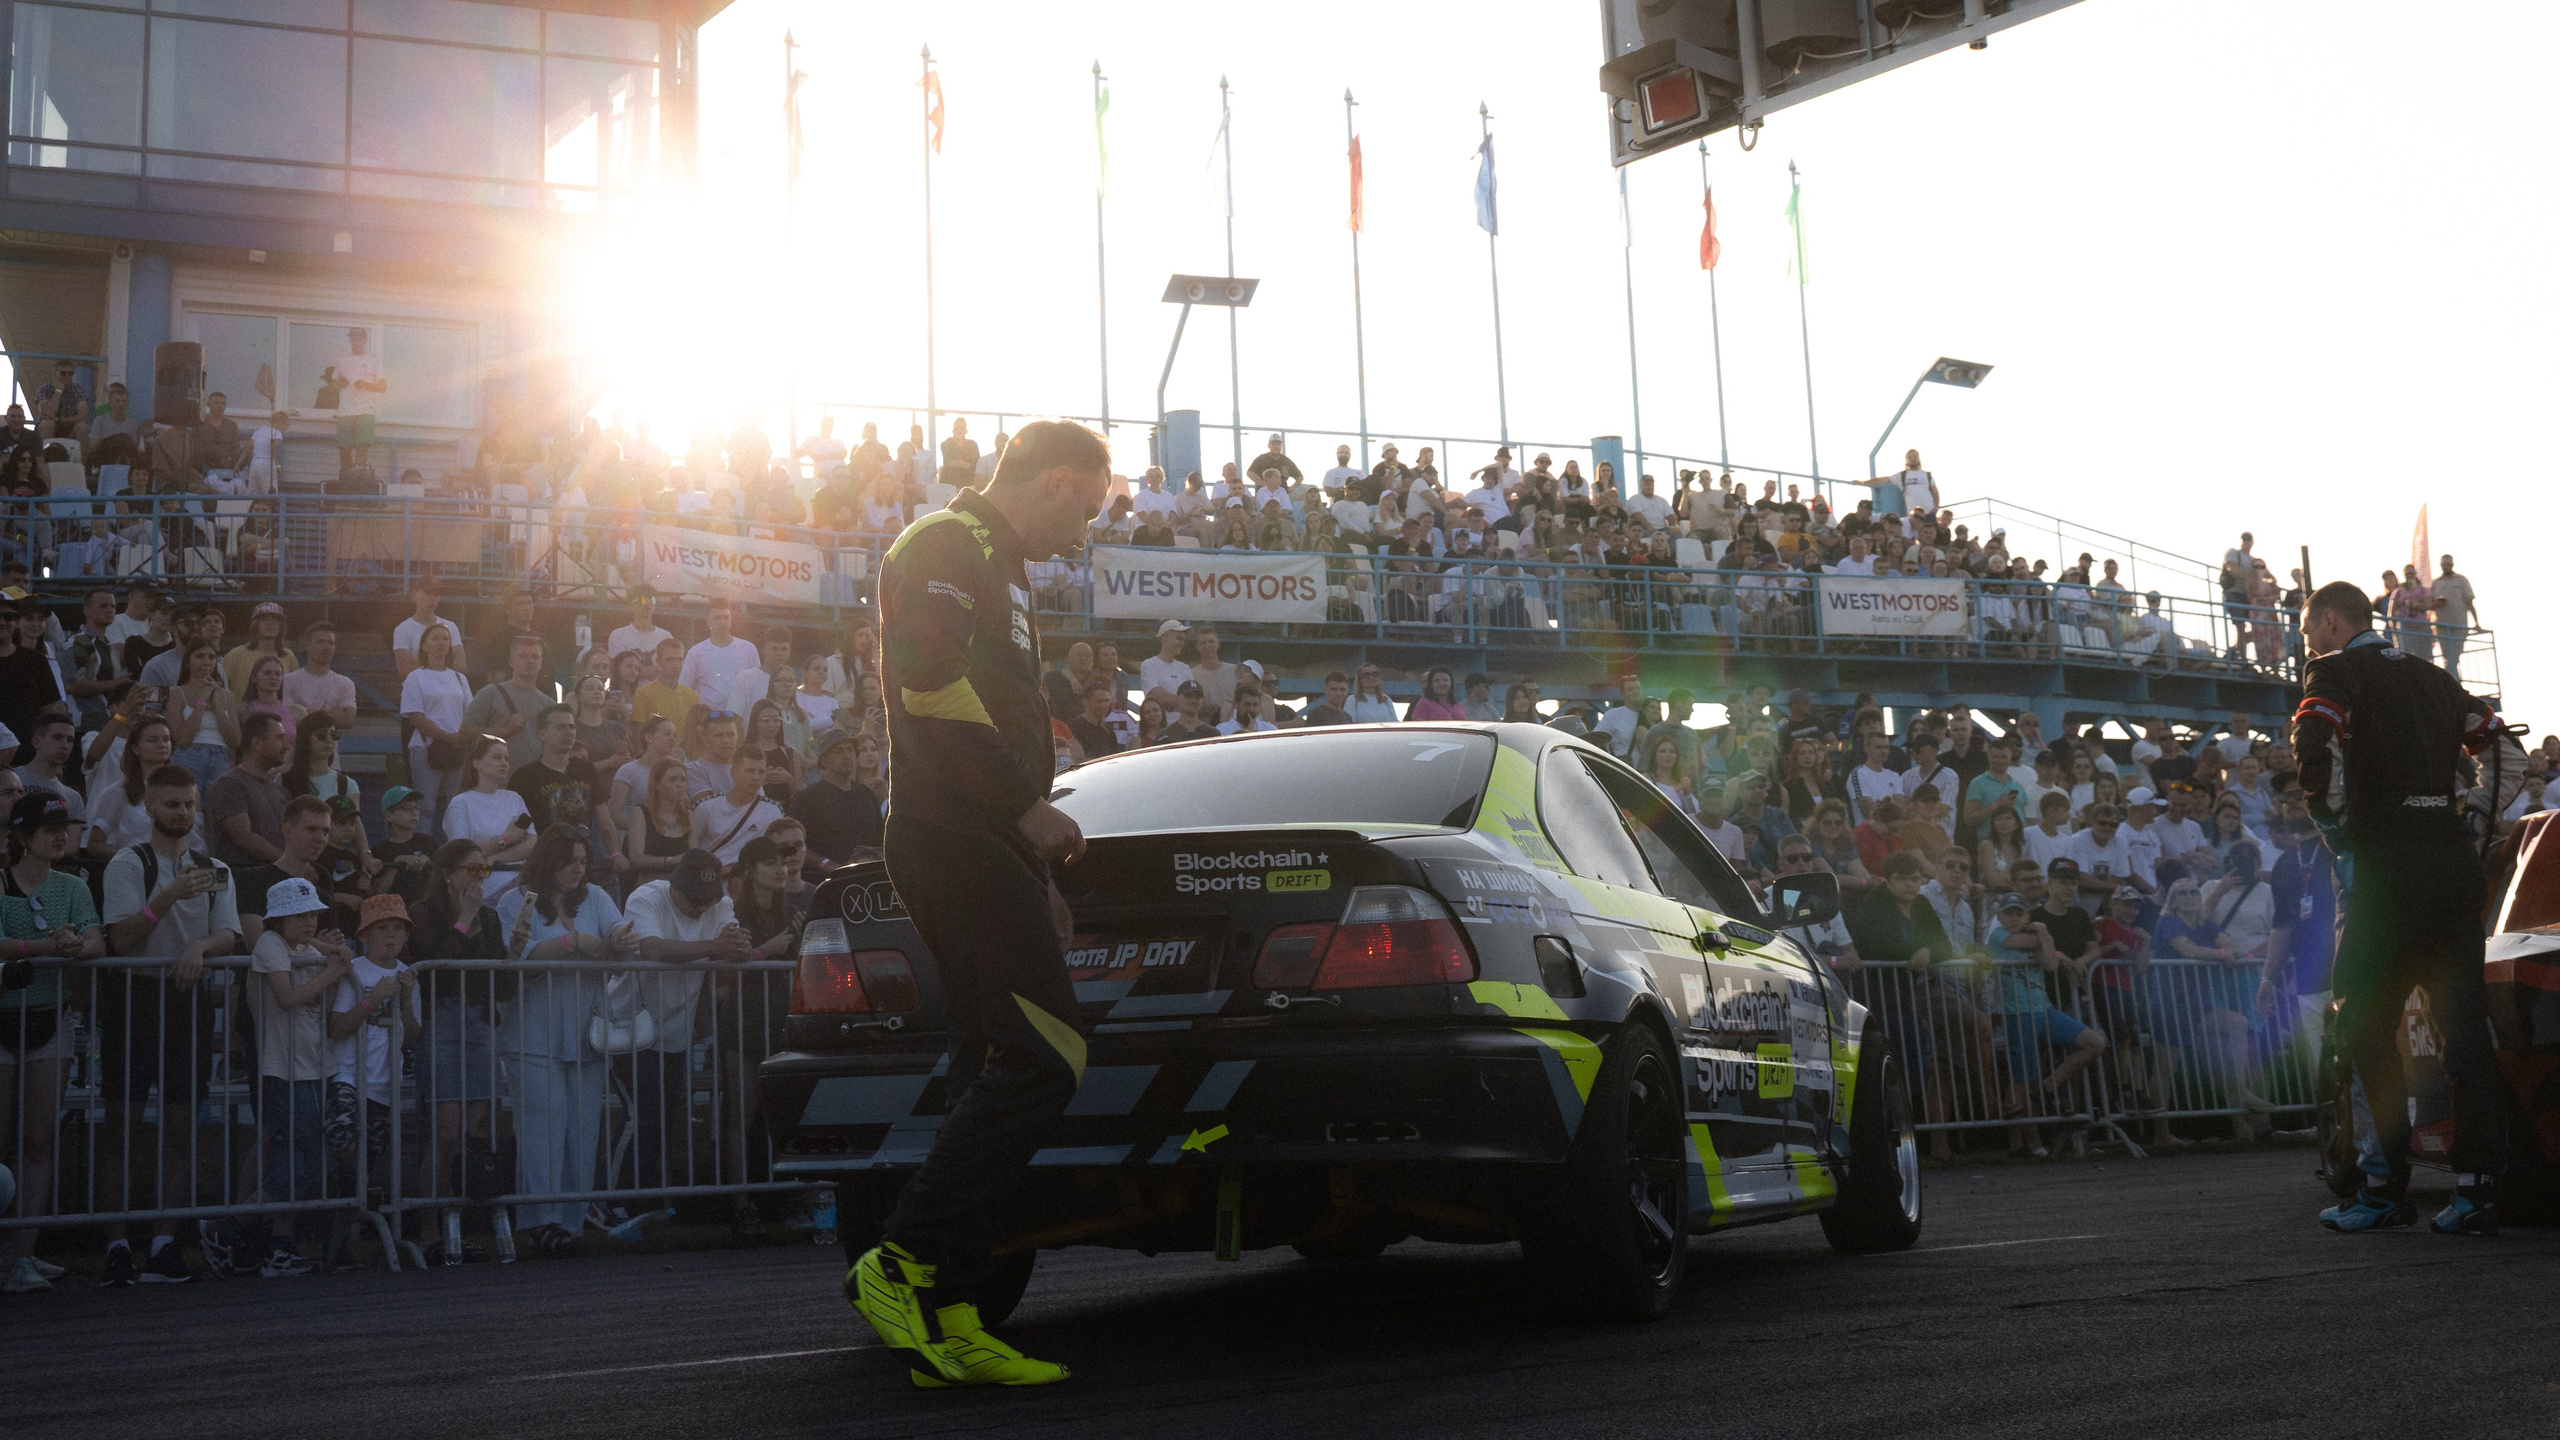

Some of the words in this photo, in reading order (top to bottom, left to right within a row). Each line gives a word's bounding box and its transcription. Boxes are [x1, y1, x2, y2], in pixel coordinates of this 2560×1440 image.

[653, 541, 812, 582] WESTMOTORS
[927, 587, 958, 598] Sports
[928, 580, 971, 601] Blockchain
[1104, 569, 1317, 601] WESTMOTORS
[1828, 592, 1959, 612] WESTMOTORS
[1409, 741, 1464, 762] 7
[2402, 795, 2448, 808] ASTARS
[1173, 849, 1313, 871] Blockchain
[1175, 872, 1261, 895] Sports
[1275, 874, 1322, 888] DRIFT
[1457, 869, 1486, 889] НА
[1483, 871, 1541, 894] ШИНАХ
[877, 890, 906, 911] LA
[1108, 943, 1139, 969] JP
[1142, 940, 1197, 967] DAY
[1680, 973, 1784, 1032] Blockchain
[1694, 1042, 1757, 1103] Sports
[1763, 1056, 1791, 1087] DRIFT
